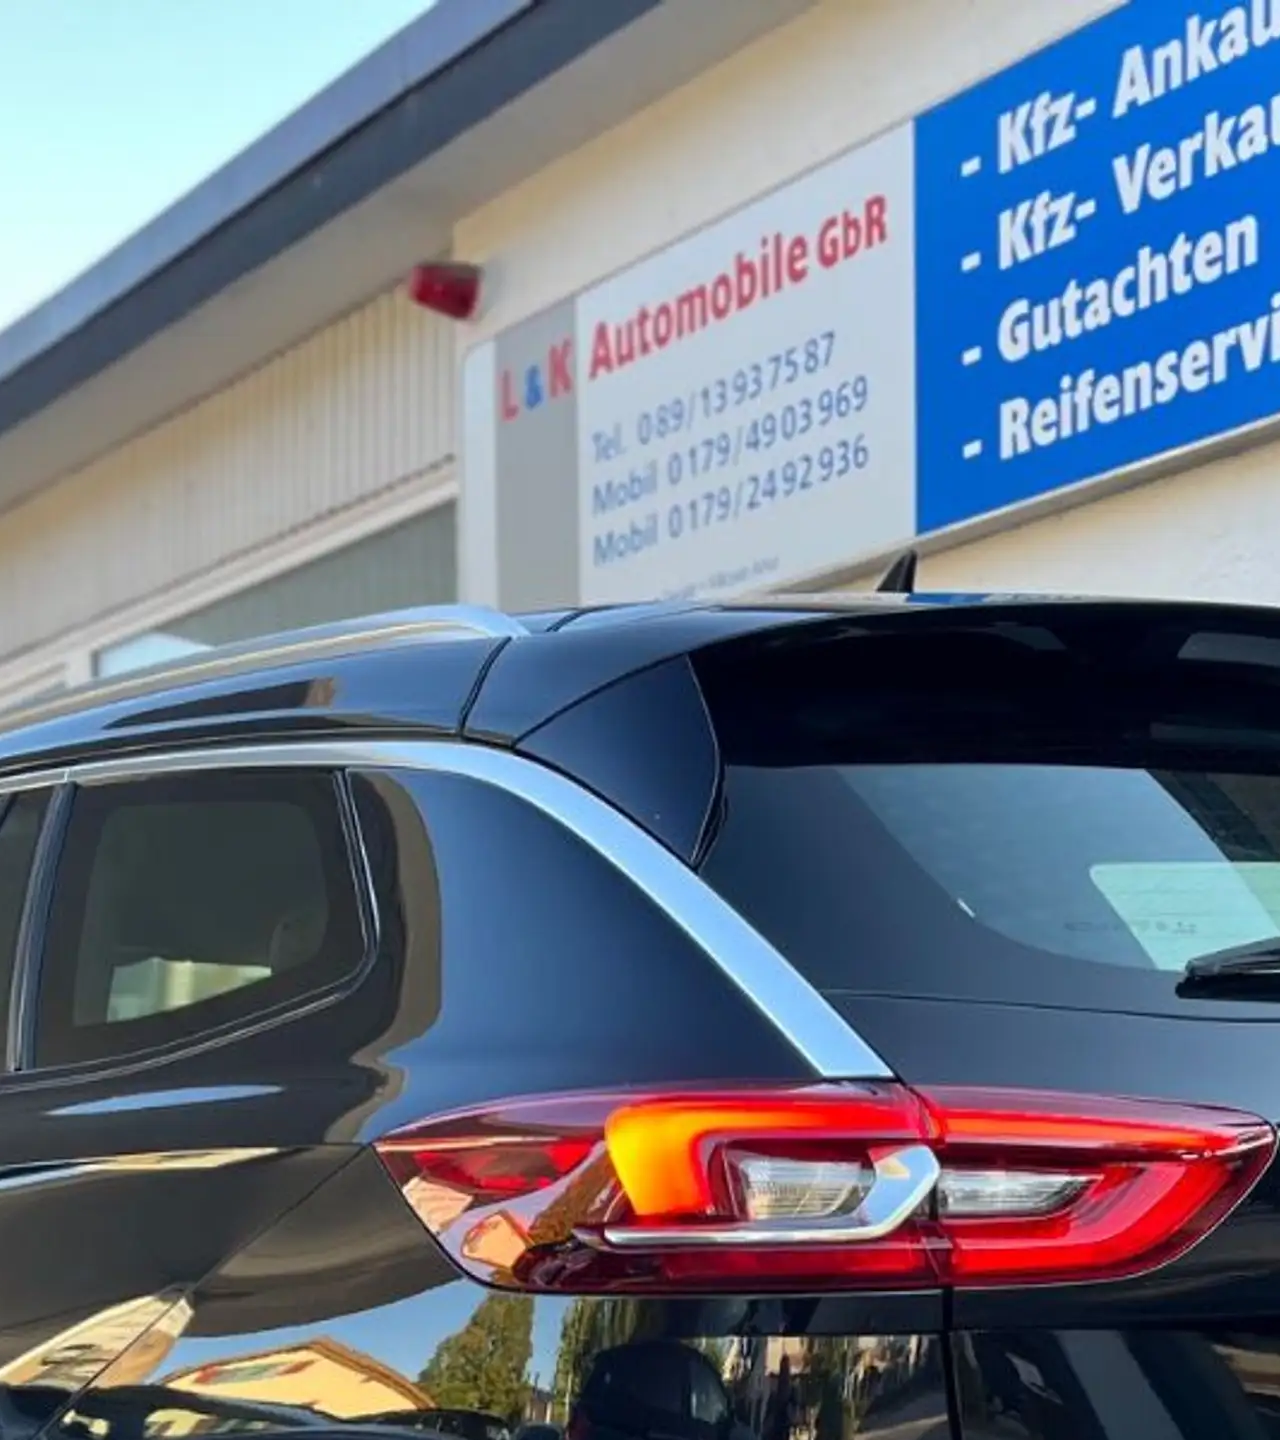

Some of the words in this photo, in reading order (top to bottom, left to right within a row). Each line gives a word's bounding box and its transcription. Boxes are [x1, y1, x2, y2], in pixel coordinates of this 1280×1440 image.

[587, 232, 809, 380] Automobile
[816, 194, 888, 269] GbR
[997, 213, 1259, 362] Gutachten
[592, 458, 658, 517] Mobil
[592, 512, 658, 568] Mobil
